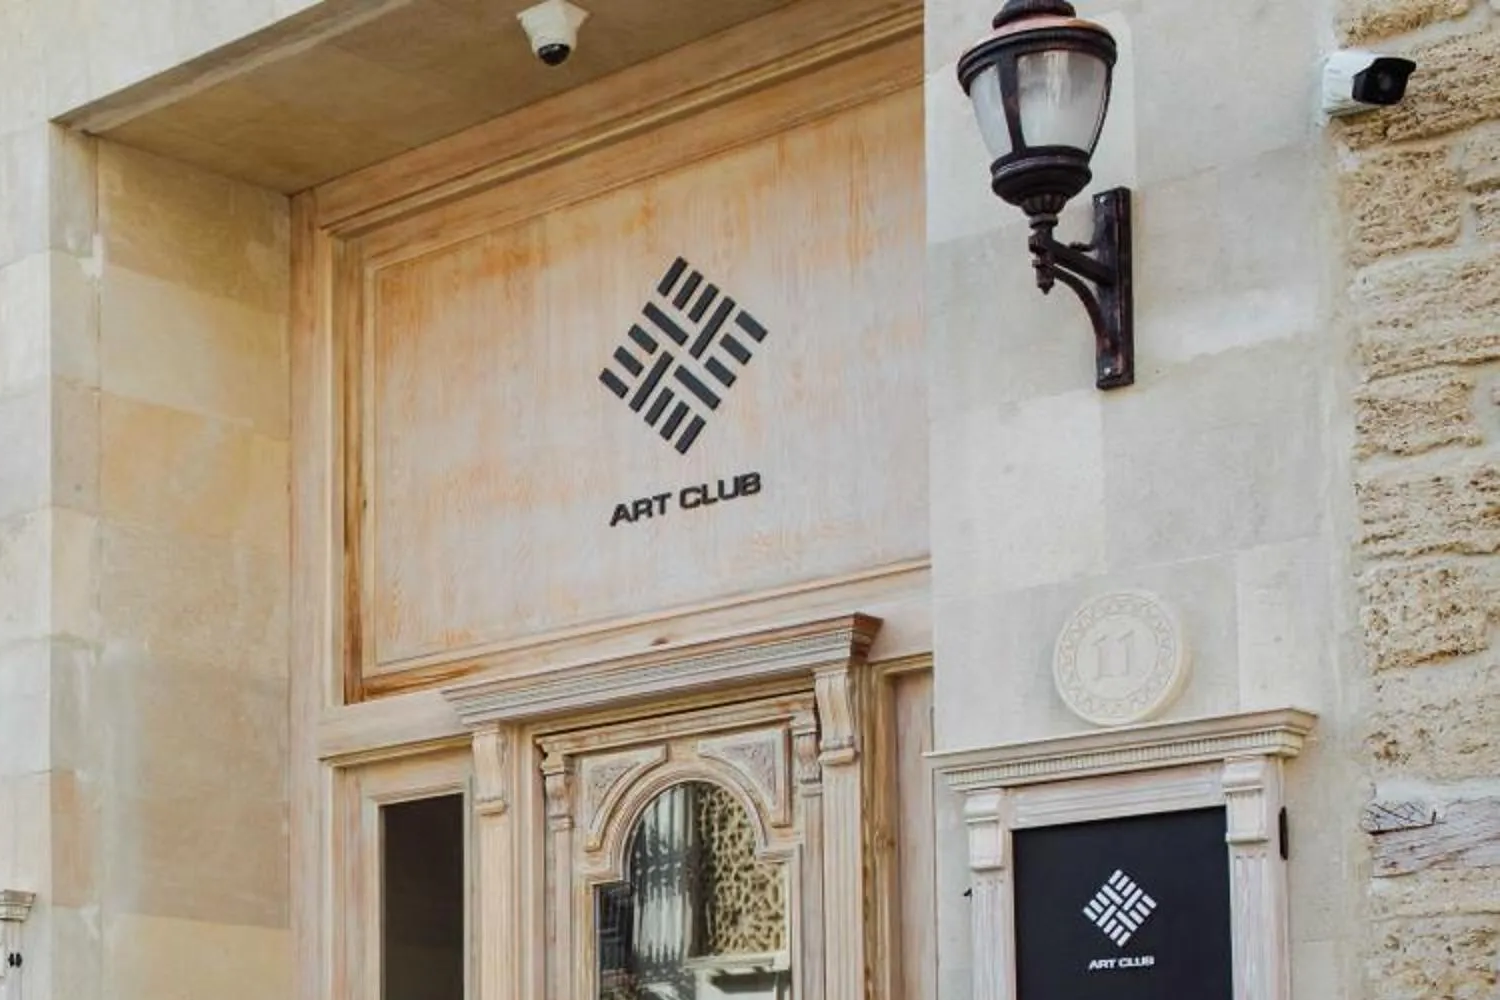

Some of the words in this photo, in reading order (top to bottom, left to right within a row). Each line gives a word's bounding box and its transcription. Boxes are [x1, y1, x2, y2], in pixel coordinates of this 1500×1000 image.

[610, 492, 672, 527] ART
[679, 472, 761, 509] CLUB
[1089, 959, 1116, 970] ART
